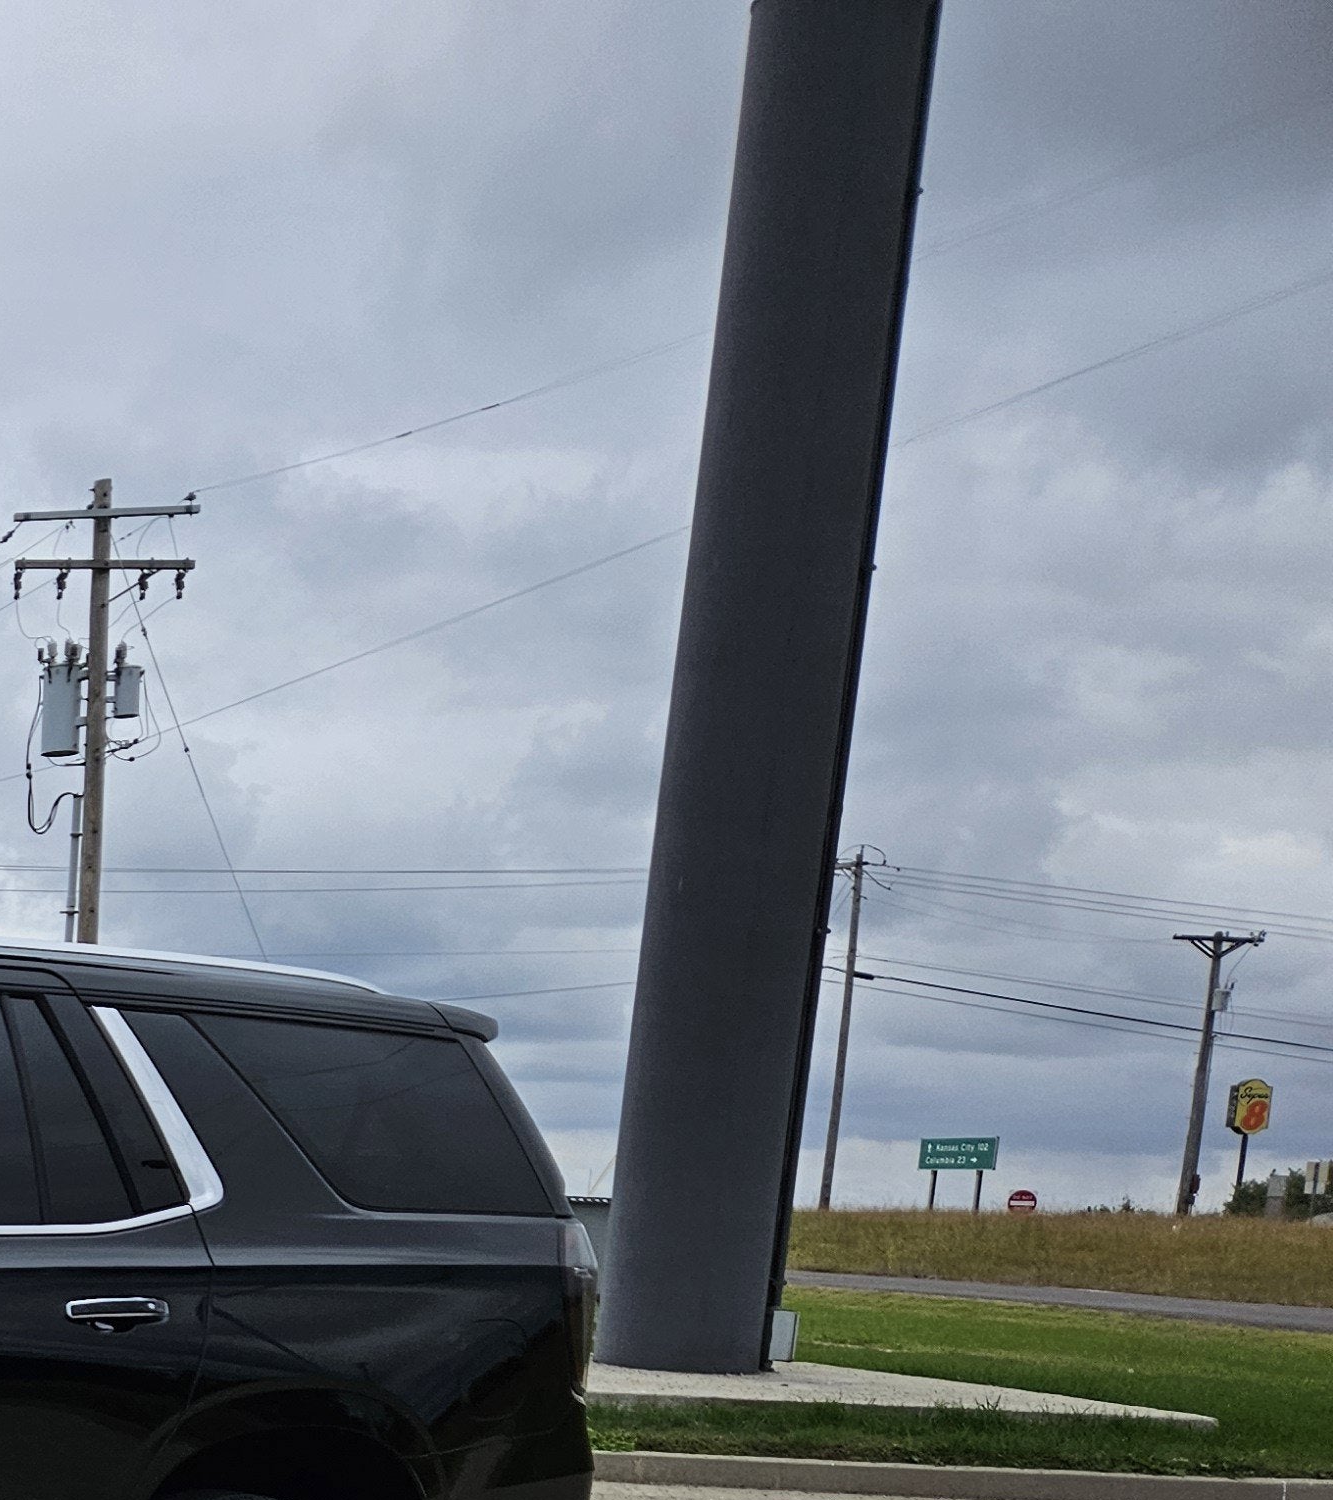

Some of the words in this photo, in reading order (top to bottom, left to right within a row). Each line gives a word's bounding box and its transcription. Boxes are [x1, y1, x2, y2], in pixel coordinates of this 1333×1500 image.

[1240, 1099, 1269, 1132] 8
[936, 1143, 959, 1152] Kansas
[960, 1143, 975, 1153] City
[925, 1156, 955, 1164] Columbia
[957, 1155, 966, 1164] 23
